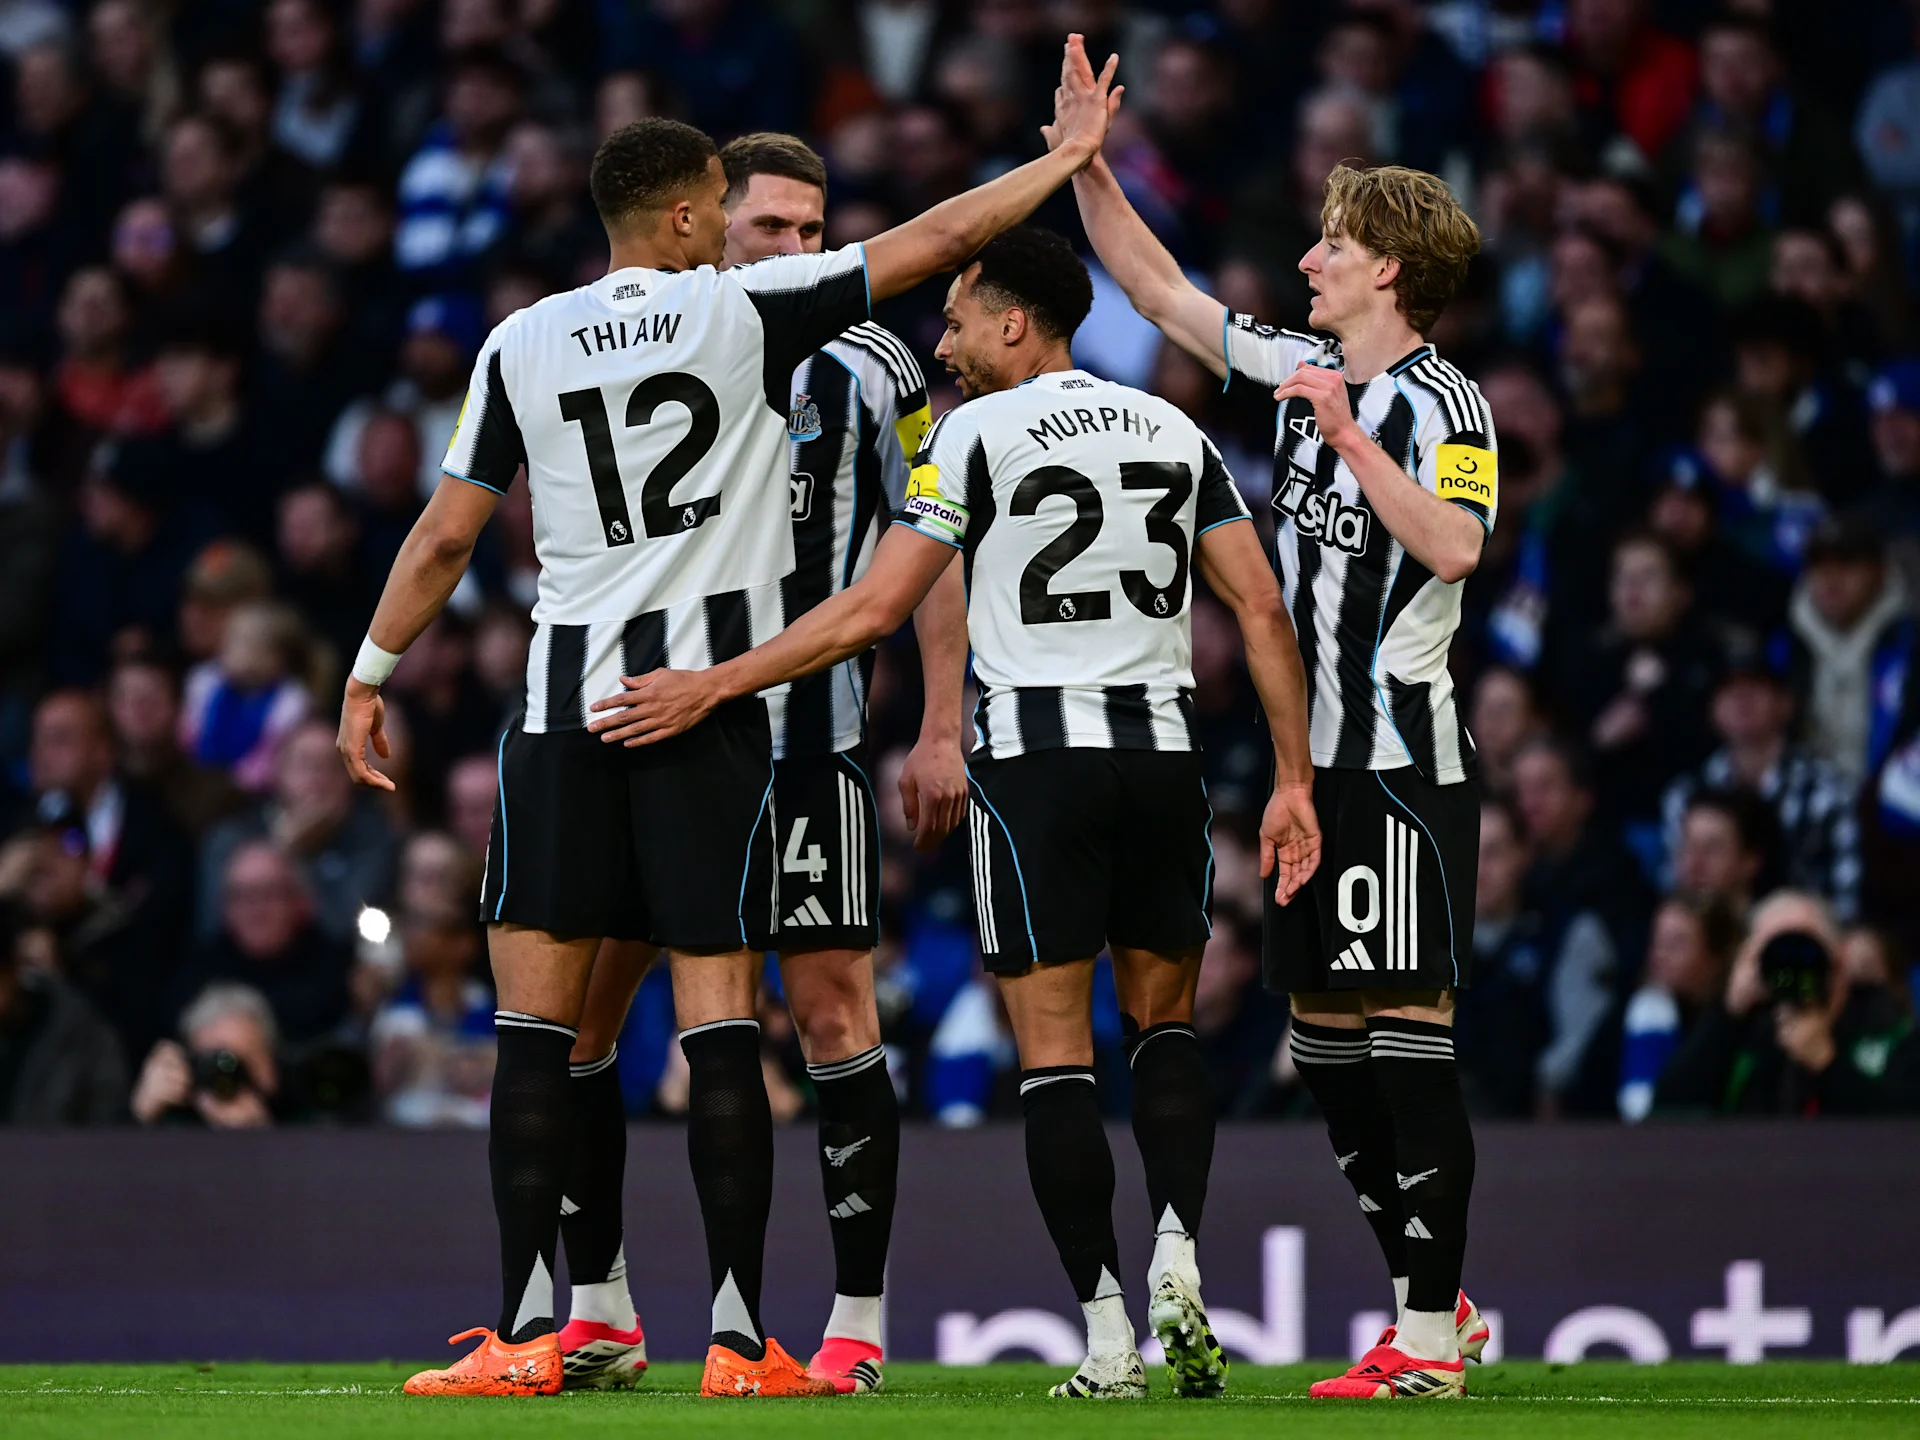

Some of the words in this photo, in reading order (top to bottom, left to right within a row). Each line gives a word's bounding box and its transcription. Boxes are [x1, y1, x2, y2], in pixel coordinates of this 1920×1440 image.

[612, 292, 625, 301] THE
[626, 290, 646, 298] LADS
[615, 283, 641, 294] HOWAY
[570, 313, 682, 357] THIAW
[1026, 407, 1162, 451] MURPHY
[557, 371, 723, 548] 12
[1440, 476, 1490, 498] noon
[909, 496, 963, 527] Captain
[1009, 461, 1193, 625] 23
[783, 817, 828, 882] 4
[1337, 865, 1381, 933] 0
